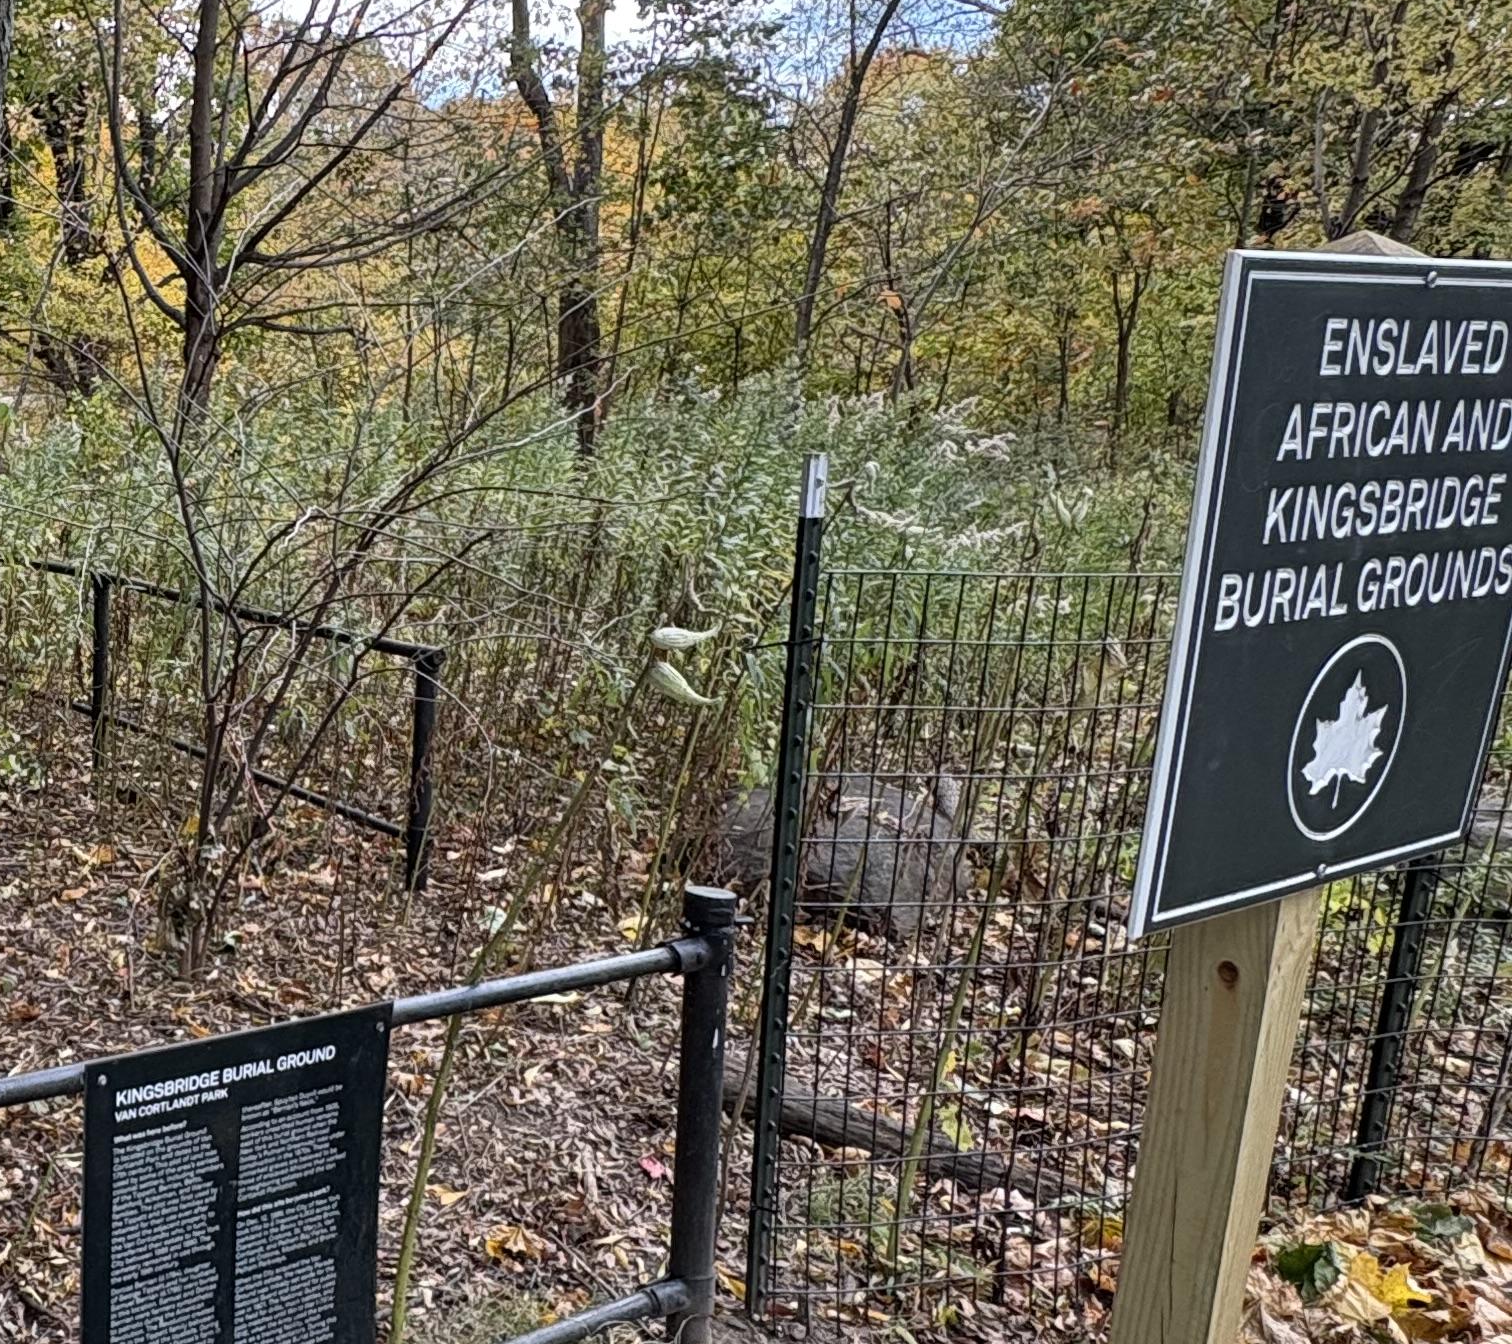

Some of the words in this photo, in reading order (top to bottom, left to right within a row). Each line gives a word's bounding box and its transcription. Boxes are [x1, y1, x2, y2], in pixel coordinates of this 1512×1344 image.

[1319, 318, 1510, 376] ENSLAVED
[1276, 399, 1441, 462] AFRICAN
[1441, 398, 1512, 453] AND
[1262, 474, 1508, 545] KINGSBRIDGE
[1213, 562, 1348, 632] BURIAL
[1357, 543, 1512, 613] GROUNDS
[114, 1108, 137, 1123] VAN
[137, 1094, 200, 1117] CORTLANDT
[201, 1087, 229, 1103] PARK
[115, 1070, 220, 1107] KINGSBRIDGE
[222, 1064, 275, 1083] BURIAL
[276, 1045, 336, 1071] GROUND
